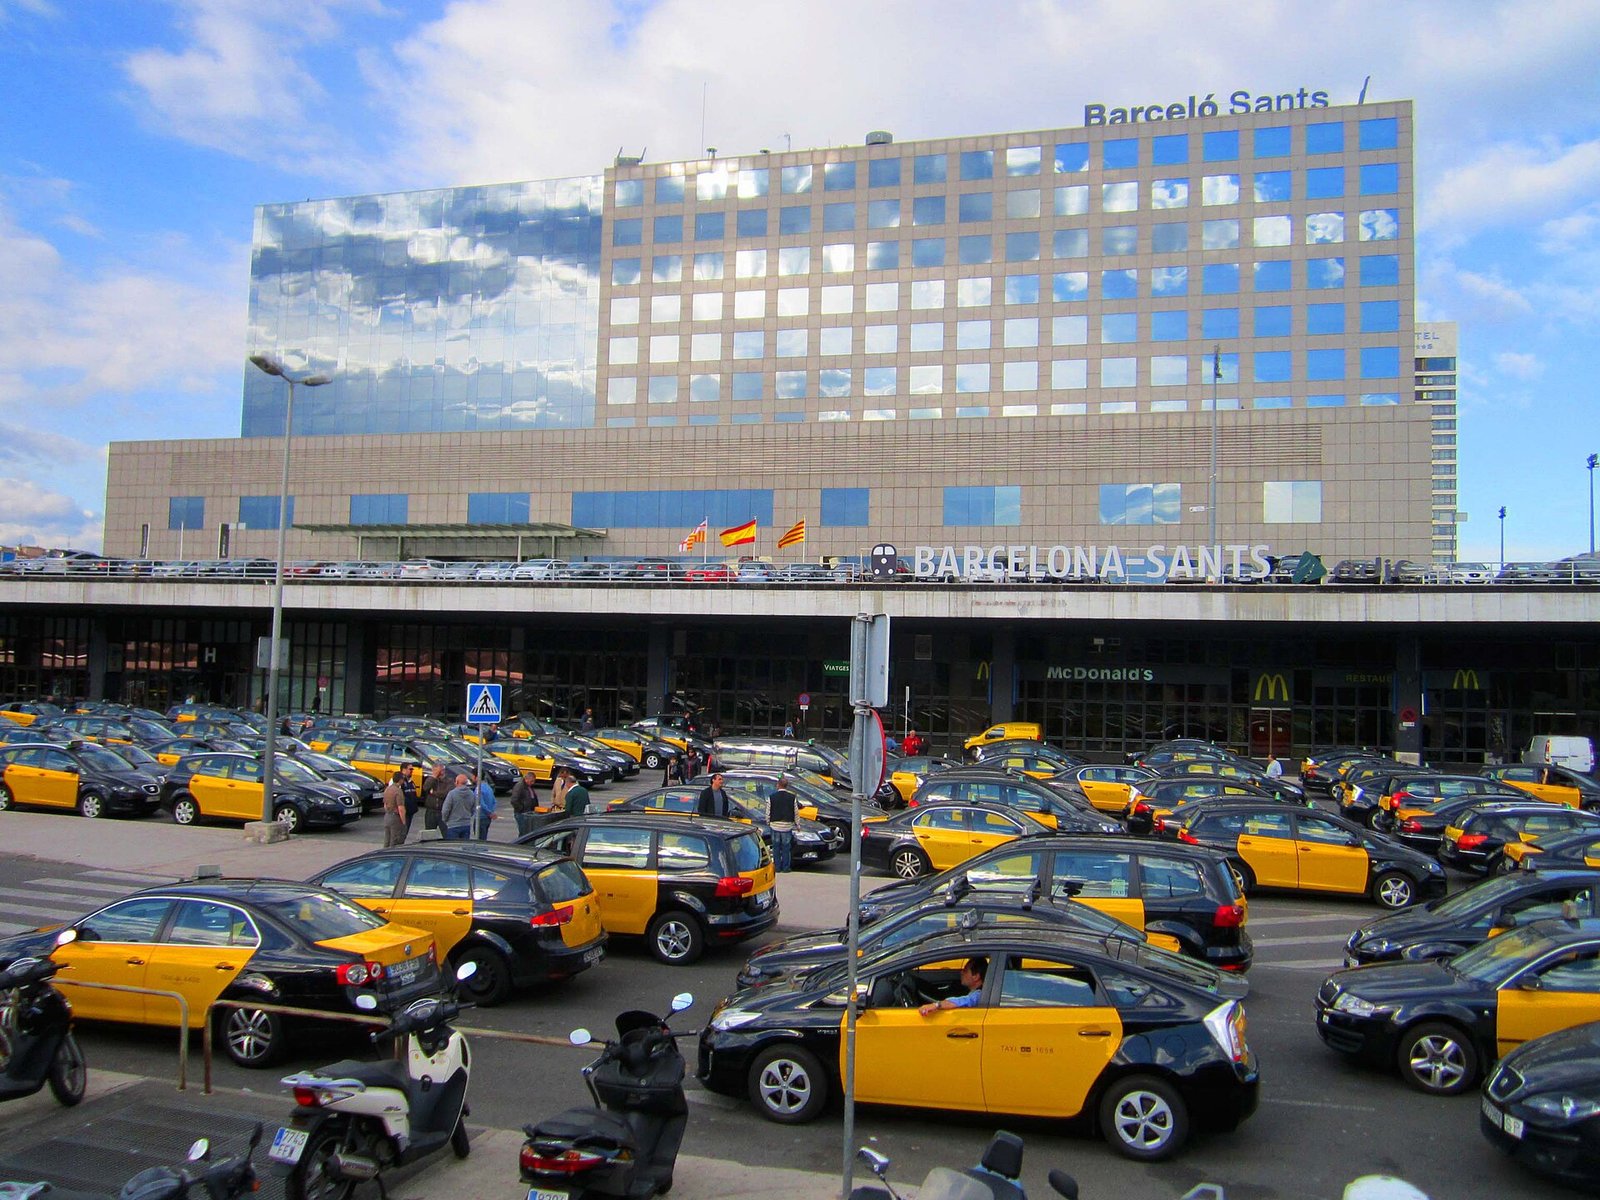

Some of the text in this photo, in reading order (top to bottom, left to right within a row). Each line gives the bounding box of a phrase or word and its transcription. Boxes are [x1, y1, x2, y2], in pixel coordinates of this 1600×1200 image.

[1084, 87, 1329, 127] Barceló Sants
[205, 647, 216, 663] H
[1047, 666, 1154, 681] McDonald's
[1001, 1045, 1017, 1053] TAXI
